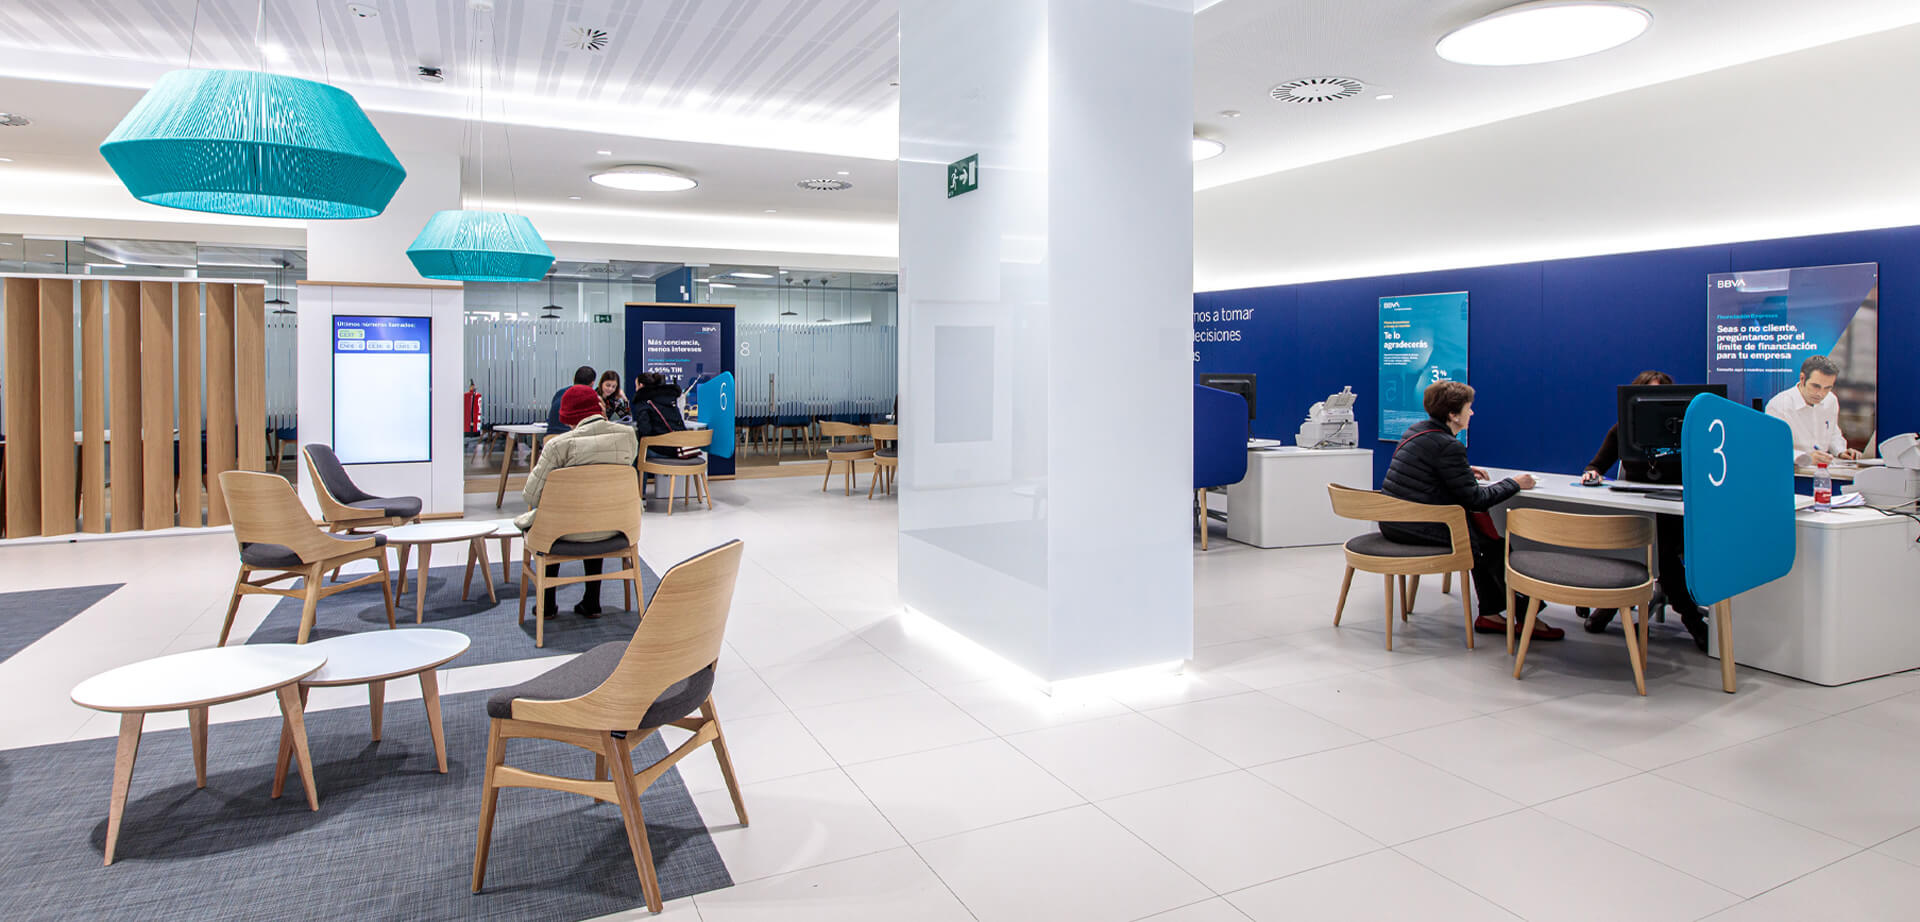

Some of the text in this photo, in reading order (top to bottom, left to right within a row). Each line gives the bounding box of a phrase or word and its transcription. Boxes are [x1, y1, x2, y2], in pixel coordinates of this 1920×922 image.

[1717, 279, 1746, 289] BBVA
[1213, 311, 1219, 322] a
[1222, 308, 1254, 321] tomar
[1717, 325, 1739, 333] Seas
[1193, 328, 1241, 342] ecisiones
[1393, 331, 1400, 339] lo
[1716, 332, 1805, 343] pregúntanos por el
[647, 338, 700, 347] Más conciencia,
[1383, 340, 1428, 350] agradecerás
[1716, 341, 1817, 351] límite de financiación
[740, 341, 750, 356] 8
[1716, 351, 1792, 361] para tu empresa
[720, 382, 728, 411] 6
[1708, 418, 1727, 487] 3
